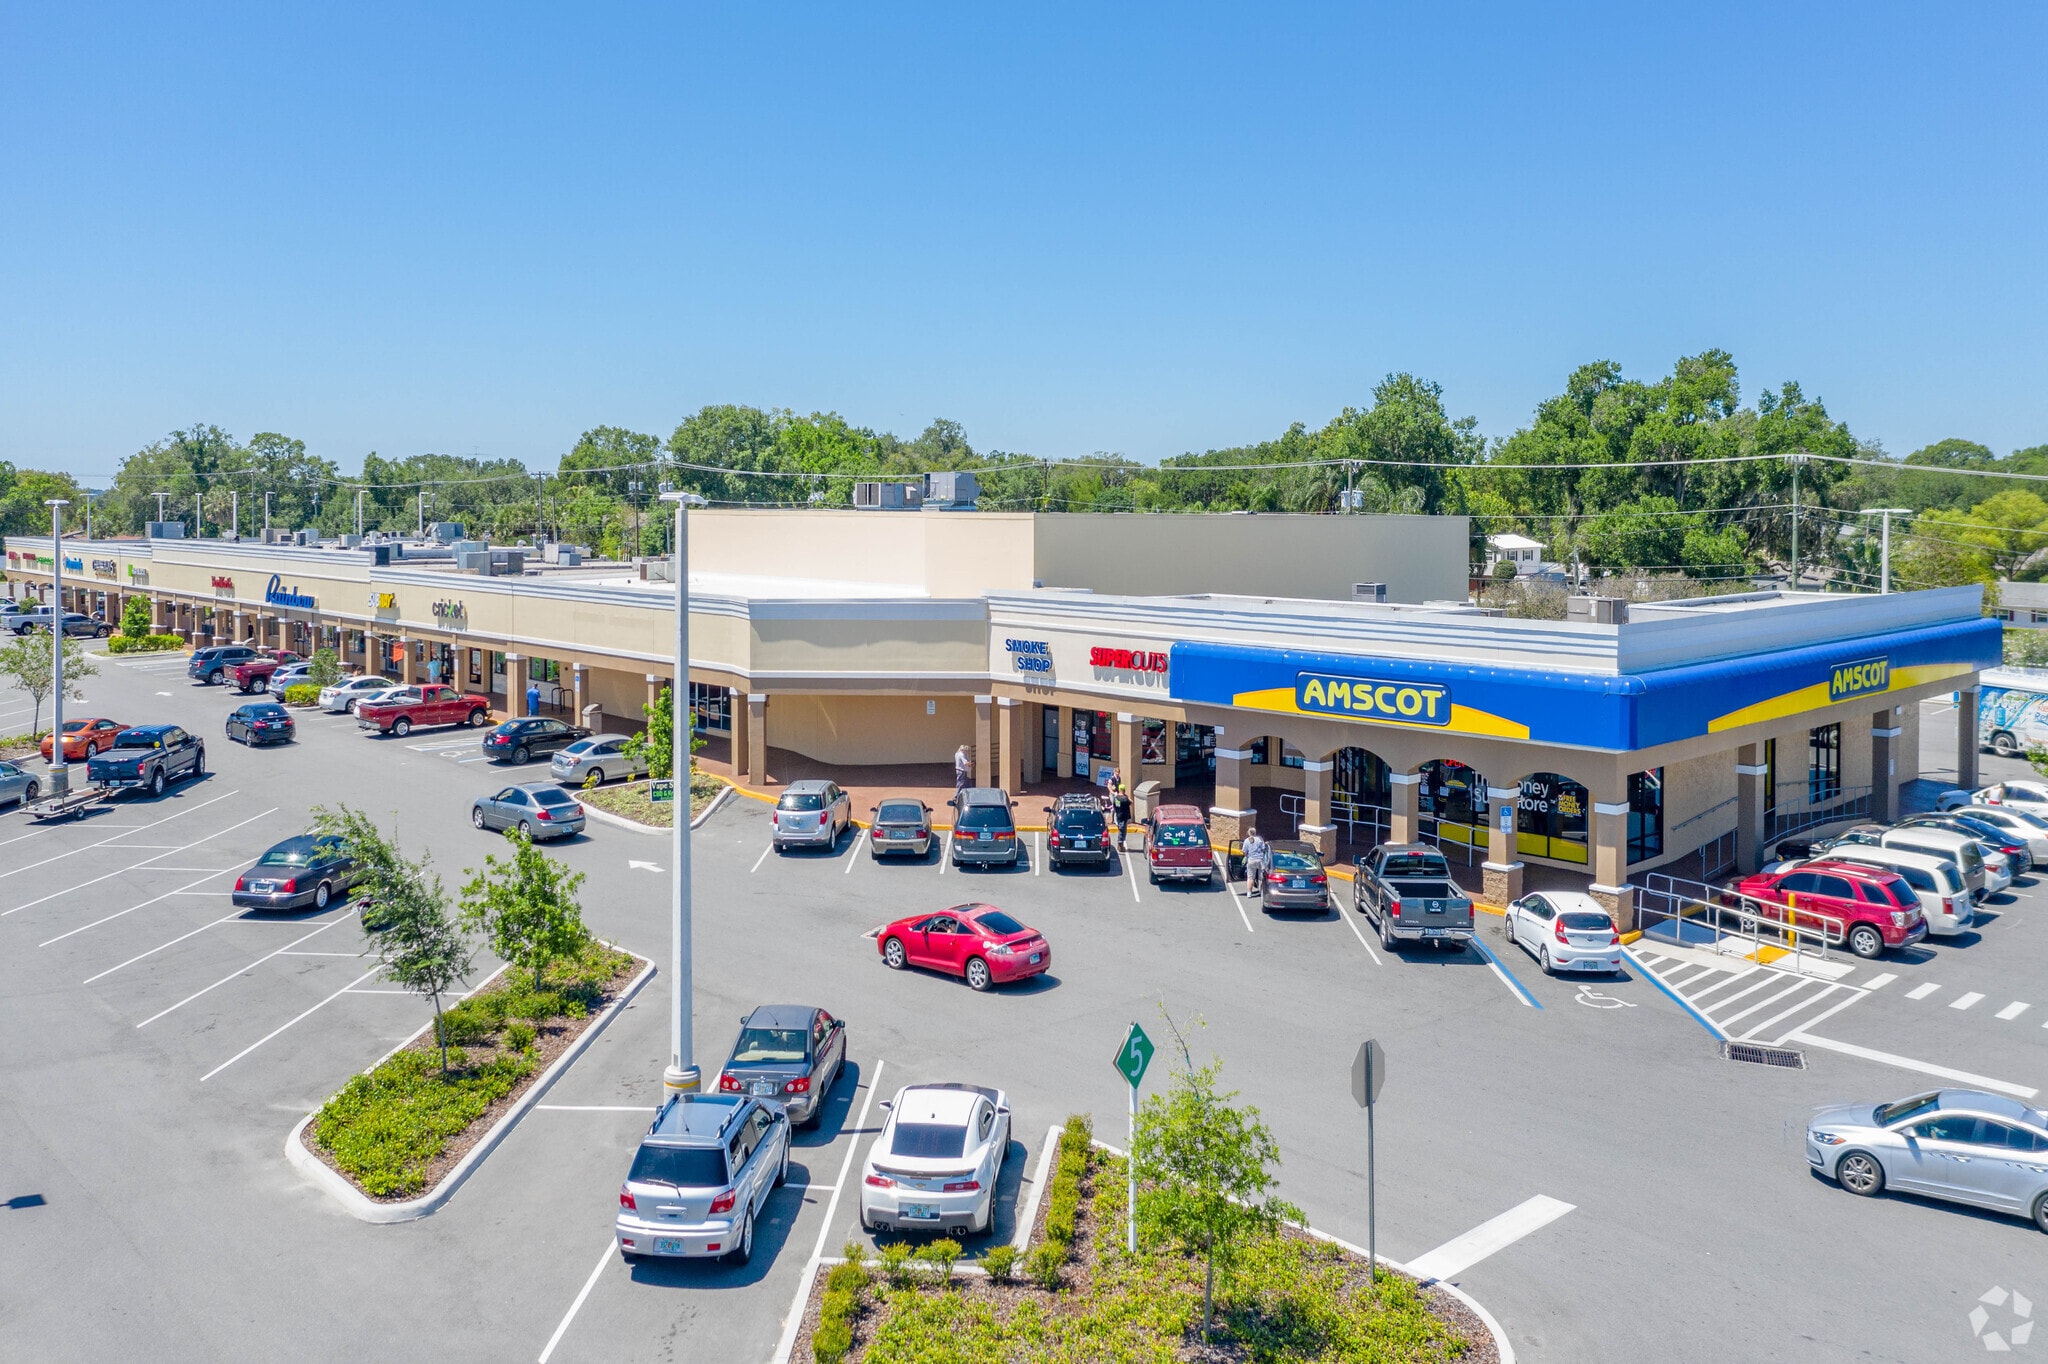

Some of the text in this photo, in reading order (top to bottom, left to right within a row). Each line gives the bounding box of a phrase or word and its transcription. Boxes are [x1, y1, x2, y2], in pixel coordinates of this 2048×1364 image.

[265, 573, 315, 608] Rainbow
[432, 598, 464, 619] cricket
[1006, 638, 1048, 655] SMOKE
[1018, 656, 1051, 673] SHOP
[1089, 646, 1168, 673] SUPERCUTS
[1832, 661, 1888, 695] AMSCOT
[1303, 678, 1443, 718] AMSCOT
[652, 782, 669, 790] Vape
[1472, 769, 1549, 798] Th oney
[1517, 794, 1549, 813] tore
[1559, 801, 1580, 809] MONEY
[1562, 795, 1576, 803] FREE
[1558, 806, 1581, 815] ORDERS
[1130, 1035, 1143, 1077] 5
